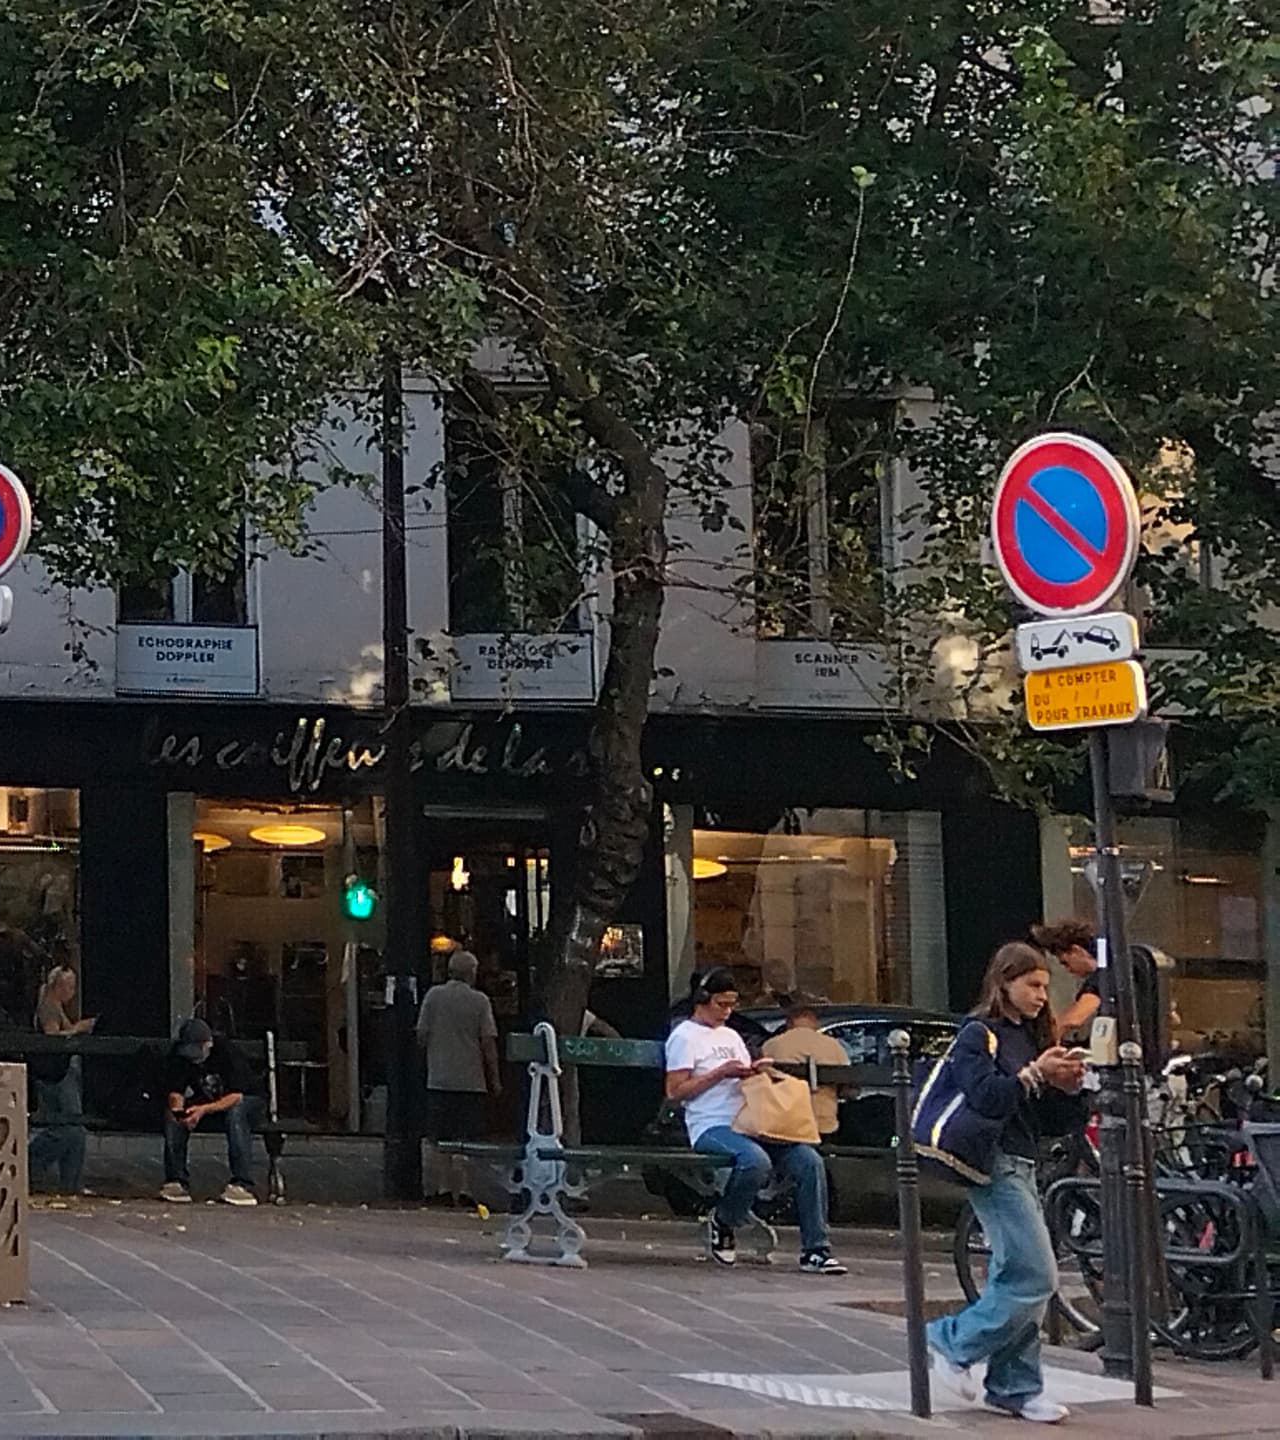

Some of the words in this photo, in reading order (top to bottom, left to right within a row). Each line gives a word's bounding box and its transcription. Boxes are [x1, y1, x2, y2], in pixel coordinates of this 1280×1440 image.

[138, 636, 234, 651] ECHOGRAPHIE
[155, 651, 215, 663] DOPPLER
[794, 653, 859, 665] SCANNER
[1057, 669, 1117, 687] COMPTER
[1033, 694, 1050, 706] DU
[1036, 707, 1069, 723] POUR
[1074, 702, 1133, 718] TRAVAUX
